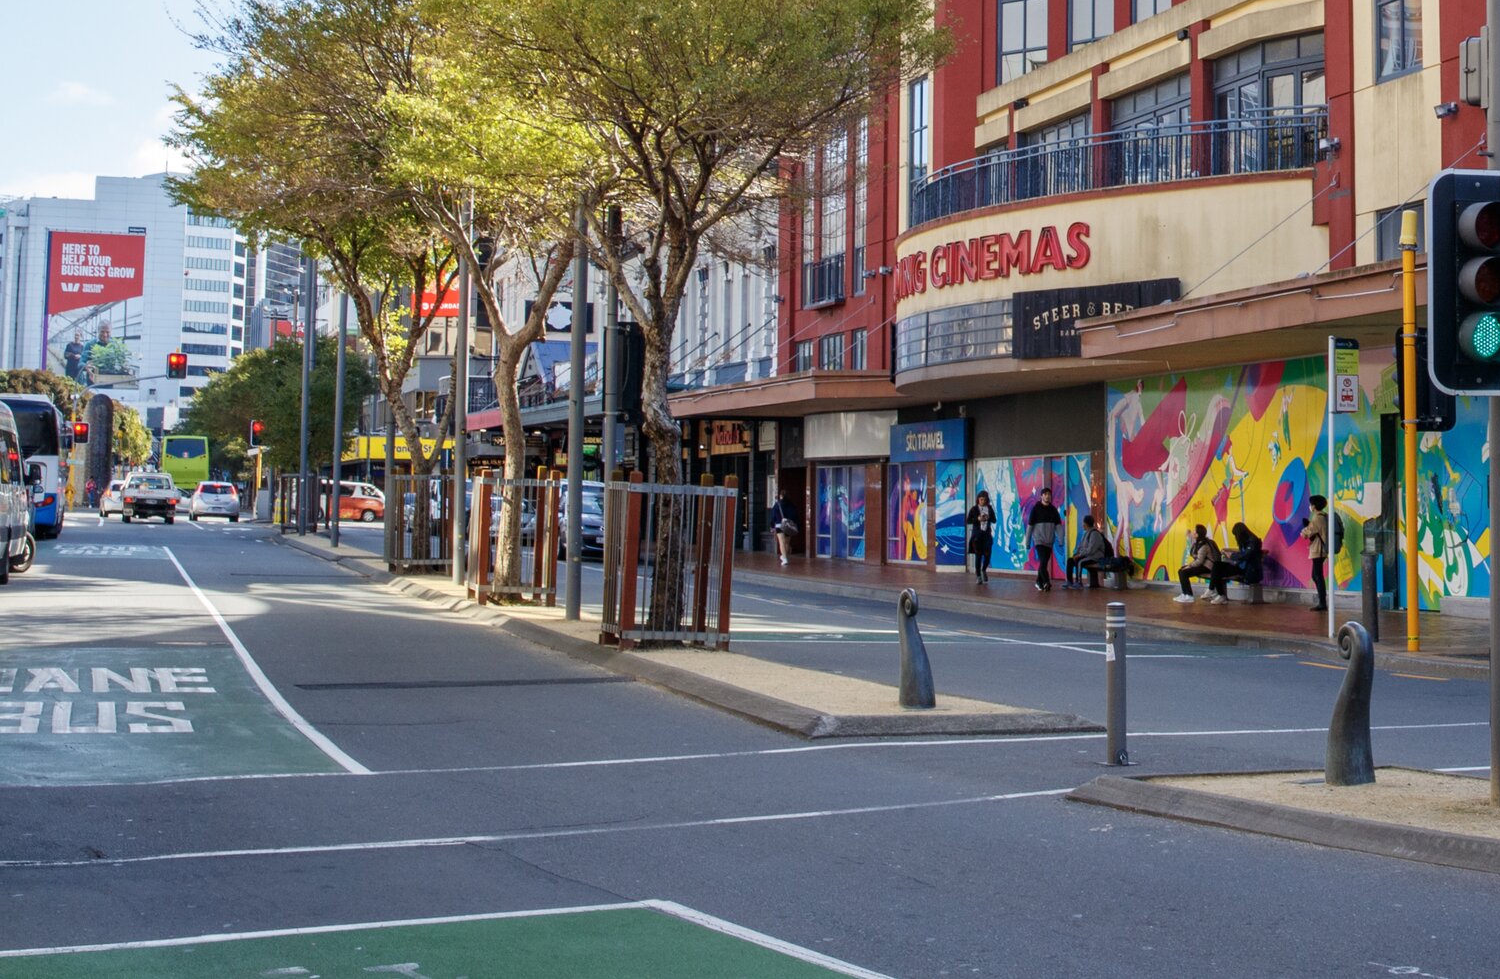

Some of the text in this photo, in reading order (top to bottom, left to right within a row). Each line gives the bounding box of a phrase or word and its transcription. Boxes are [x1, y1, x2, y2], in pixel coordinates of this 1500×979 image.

[62, 243, 100, 255] HERE TO
[929, 222, 1090, 289] CINEMAS
[61, 254, 112, 267] HELP YOUR
[61, 265, 135, 279] BUSINESS GROW
[1032, 303, 1081, 330] STEER
[1086, 301, 1096, 316] &
[918, 430, 945, 451] TRAVEL
